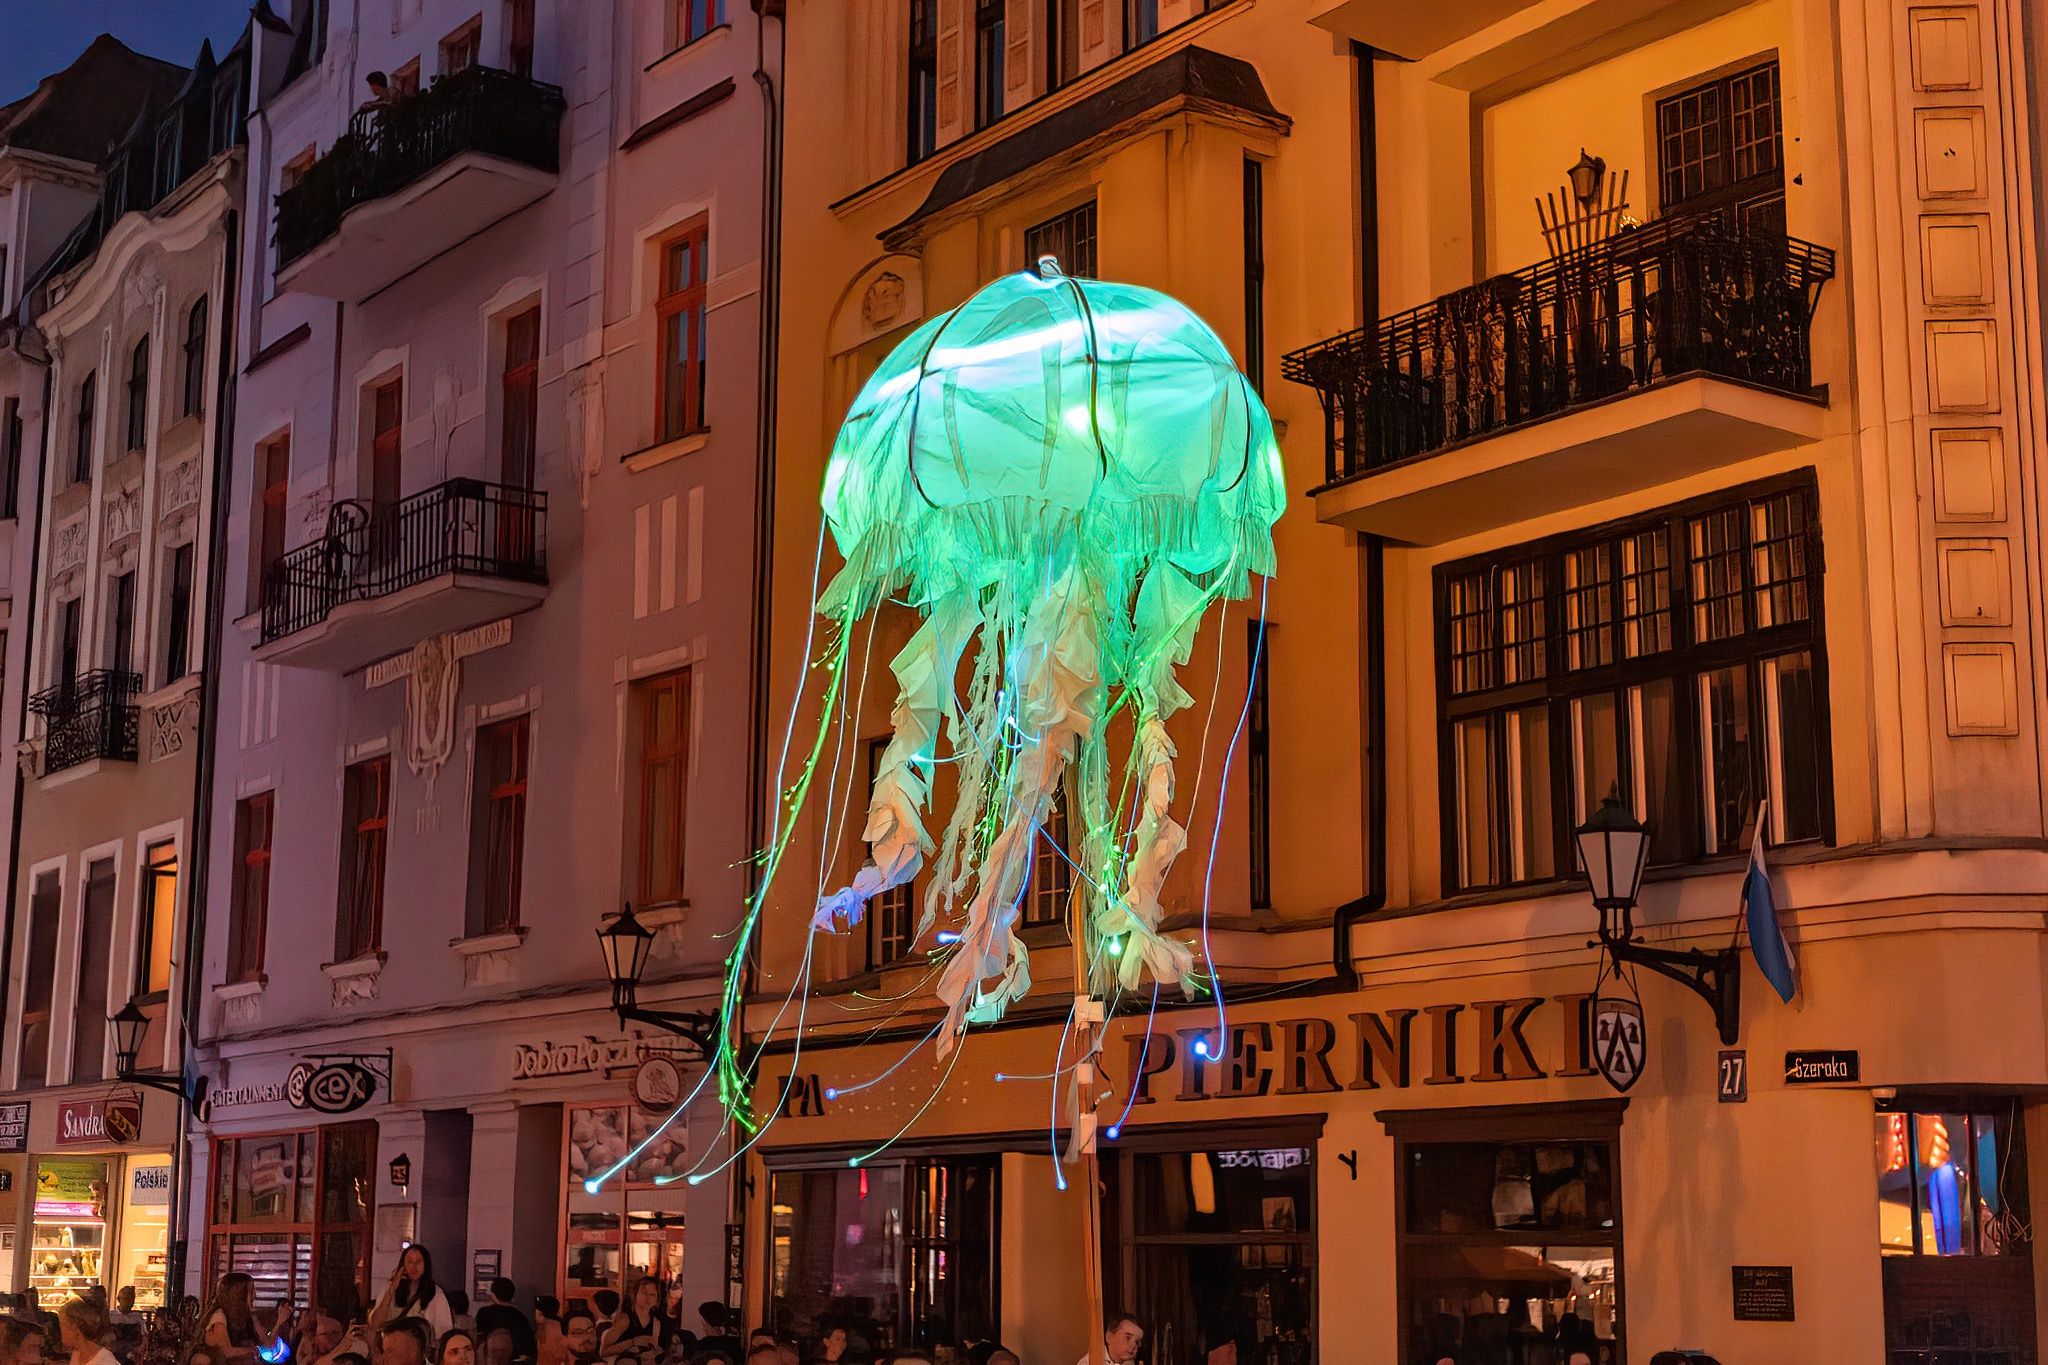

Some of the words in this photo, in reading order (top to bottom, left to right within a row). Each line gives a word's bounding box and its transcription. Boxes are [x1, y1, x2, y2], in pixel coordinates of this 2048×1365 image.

[1122, 992, 1600, 1105] PIERNIKI
[1722, 1058, 1743, 1094] 27
[1794, 1056, 1848, 1079] Szeroka
